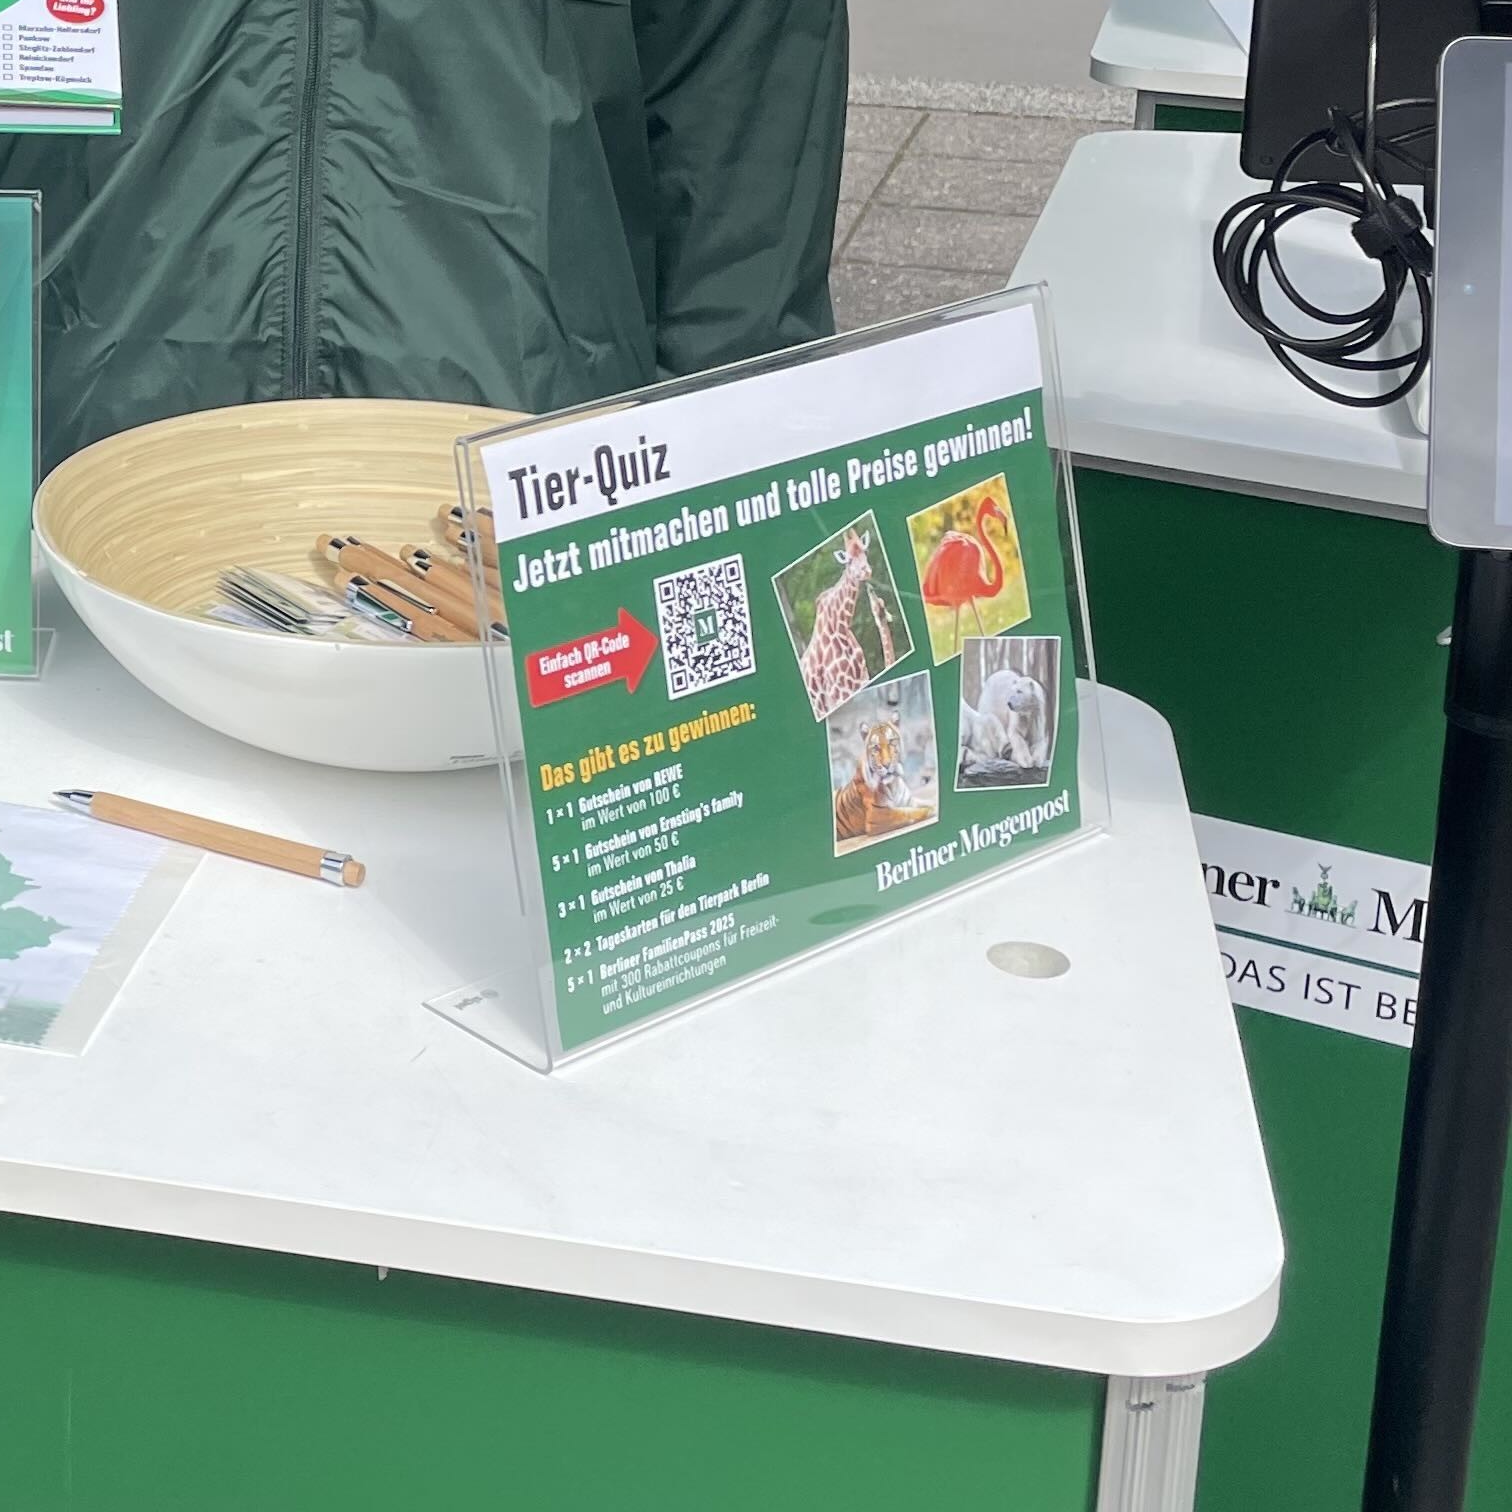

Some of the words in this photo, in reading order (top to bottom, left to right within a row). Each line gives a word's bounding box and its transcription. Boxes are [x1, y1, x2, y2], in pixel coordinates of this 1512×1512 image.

[508, 435, 670, 520] Tier-Quiz
[512, 541, 583, 592] Jetzt
[588, 504, 729, 570] mitmachen
[735, 481, 781, 527] und
[787, 467, 841, 511] tolle
[846, 448, 918, 493] Preise
[923, 407, 1033, 478] gewinnen!
[539, 647, 582, 676] Einfach
[583, 633, 630, 662] QR-Code
[563, 661, 612, 688] scannen
[540, 762, 575, 791] Das
[579, 744, 615, 783] gibt
[618, 740, 640, 764] es
[643, 731, 665, 756] zu
[668, 702, 757, 753] gewinnen:
[546, 808, 554, 825] 1
[565, 801, 574, 818] 1
[578, 783, 631, 814] Gutschein
[632, 777, 653, 794] von
[654, 763, 683, 788] REWE
[581, 816, 596, 831] im
[597, 804, 625, 825] Wert
[626, 799, 647, 815] von
[649, 786, 670, 808] 100
[671, 782, 681, 799] €
[551, 855, 560, 871] 5
[571, 849, 580, 865] 1
[584, 829, 637, 860] Gutschein
[639, 823, 658, 840] von
[659, 802, 711, 833] Ernsting's
[711, 790, 744, 812] family
[587, 862, 602, 878] im
[603, 850, 630, 871] Wert
[632, 844, 652, 861] von
[654, 834, 669, 854] 50
[670, 831, 680, 847] €
[875, 840, 958, 892] Berliner
[958, 789, 1071, 858] Morgenpost
[558, 901, 567, 918] 3
[578, 894, 586, 911] 1
[590, 875, 643, 906] Gutschein
[644, 869, 664, 886] von
[664, 855, 697, 876] Thalia
[564, 948, 573, 965] 2
[583, 941, 592, 958] 2
[595, 916, 659, 953] Tageskarten
[660, 908, 675, 927] für
[677, 901, 697, 920] den
[698, 883, 739, 914] Tierpark
[740, 871, 770, 895] Berlin
[593, 908, 607, 924] im
[609, 897, 636, 918] Wert
[638, 891, 658, 907] von
[659, 879, 674, 899] 25
[676, 875, 685, 891] €
[567, 976, 575, 993] 5
[587, 969, 594, 985] 1
[599, 954, 641, 980] Berliner
[642, 927, 708, 962] FamilienPass
[709, 912, 735, 937] 2025
[600, 980, 619, 998] mit
[621, 969, 642, 988] 300
[644, 939, 721, 981] Rabattcoupons
[723, 931, 738, 949] für
[740, 913, 780, 941] Freizeit-
[1219, 951, 1286, 993] DAS
[1303, 973, 1361, 1010] IST
[602, 996, 623, 1015] und
[625, 954, 727, 1005] Kultureinrichtungen
